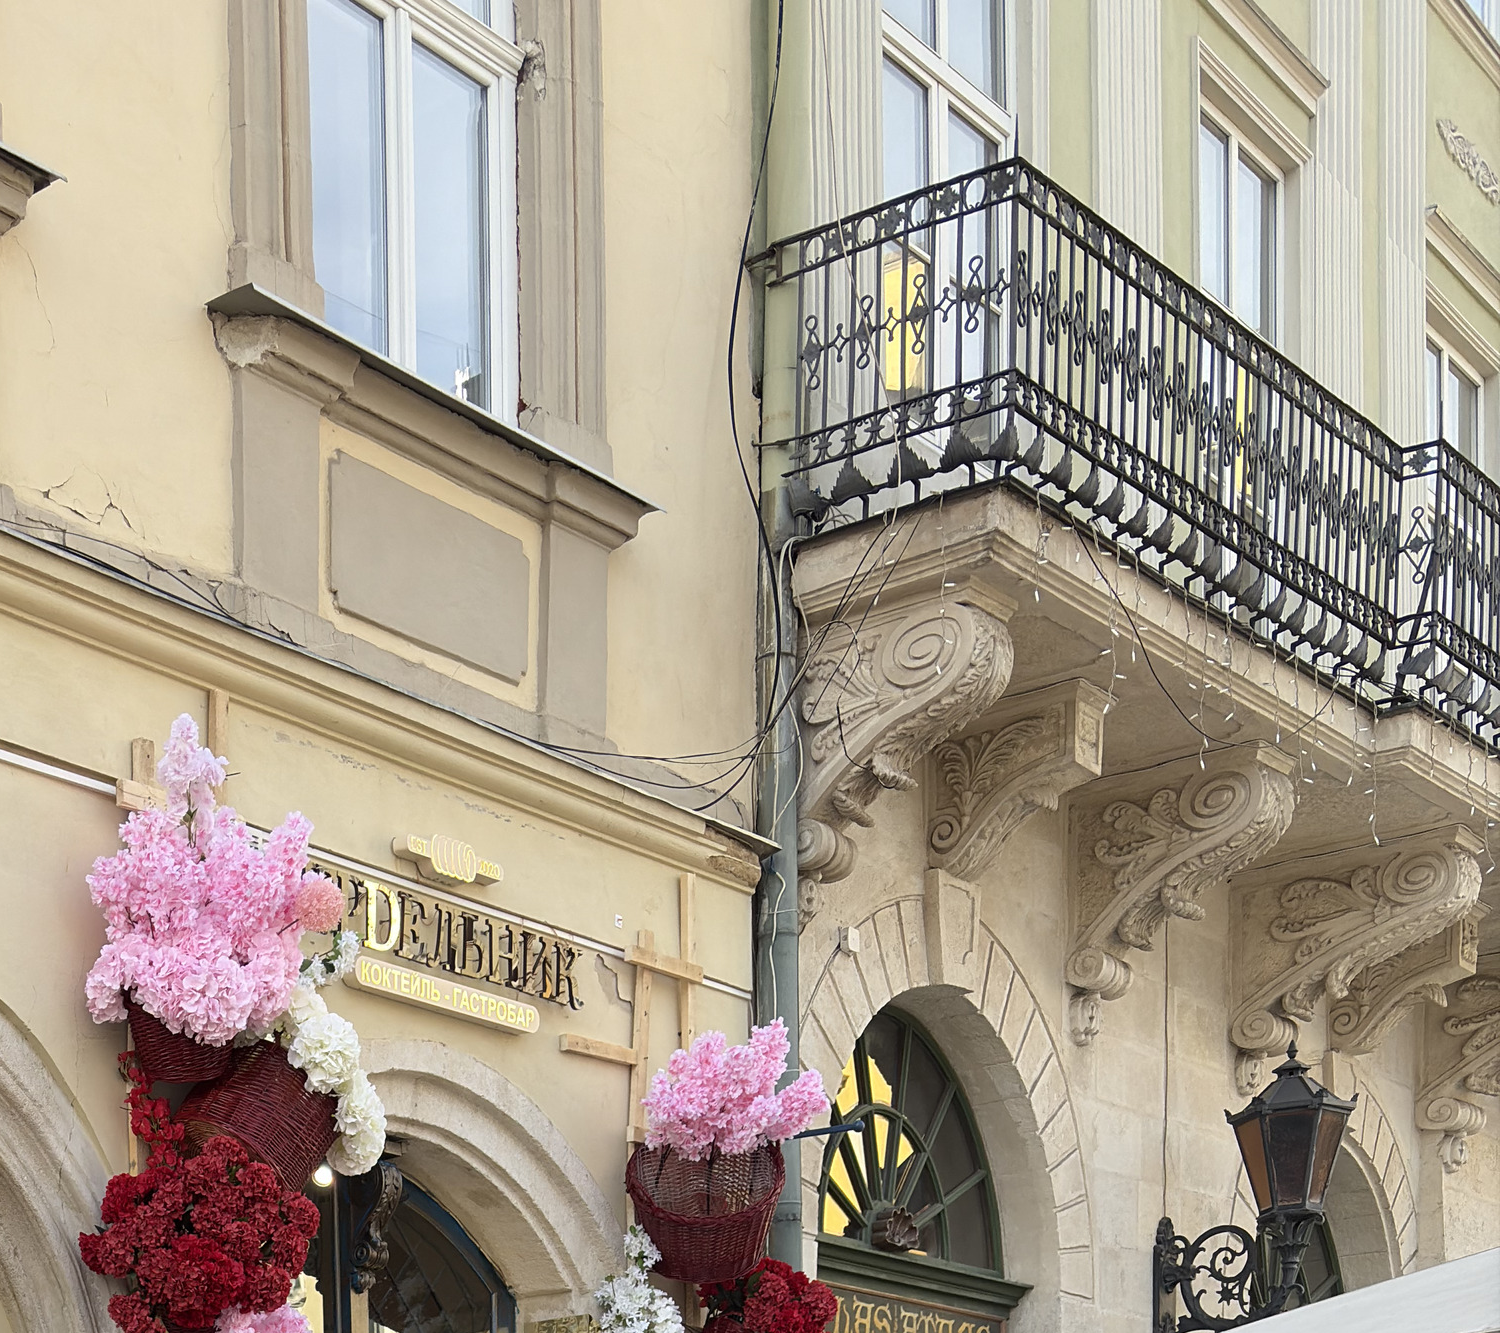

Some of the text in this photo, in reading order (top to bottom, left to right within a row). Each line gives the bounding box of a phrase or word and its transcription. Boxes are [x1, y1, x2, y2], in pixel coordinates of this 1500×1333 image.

[478, 860, 501, 879] 2020
[360, 960, 441, 1002] КОКТЕЙЛЬ
[453, 987, 535, 1028] ГАСТРОБАР
